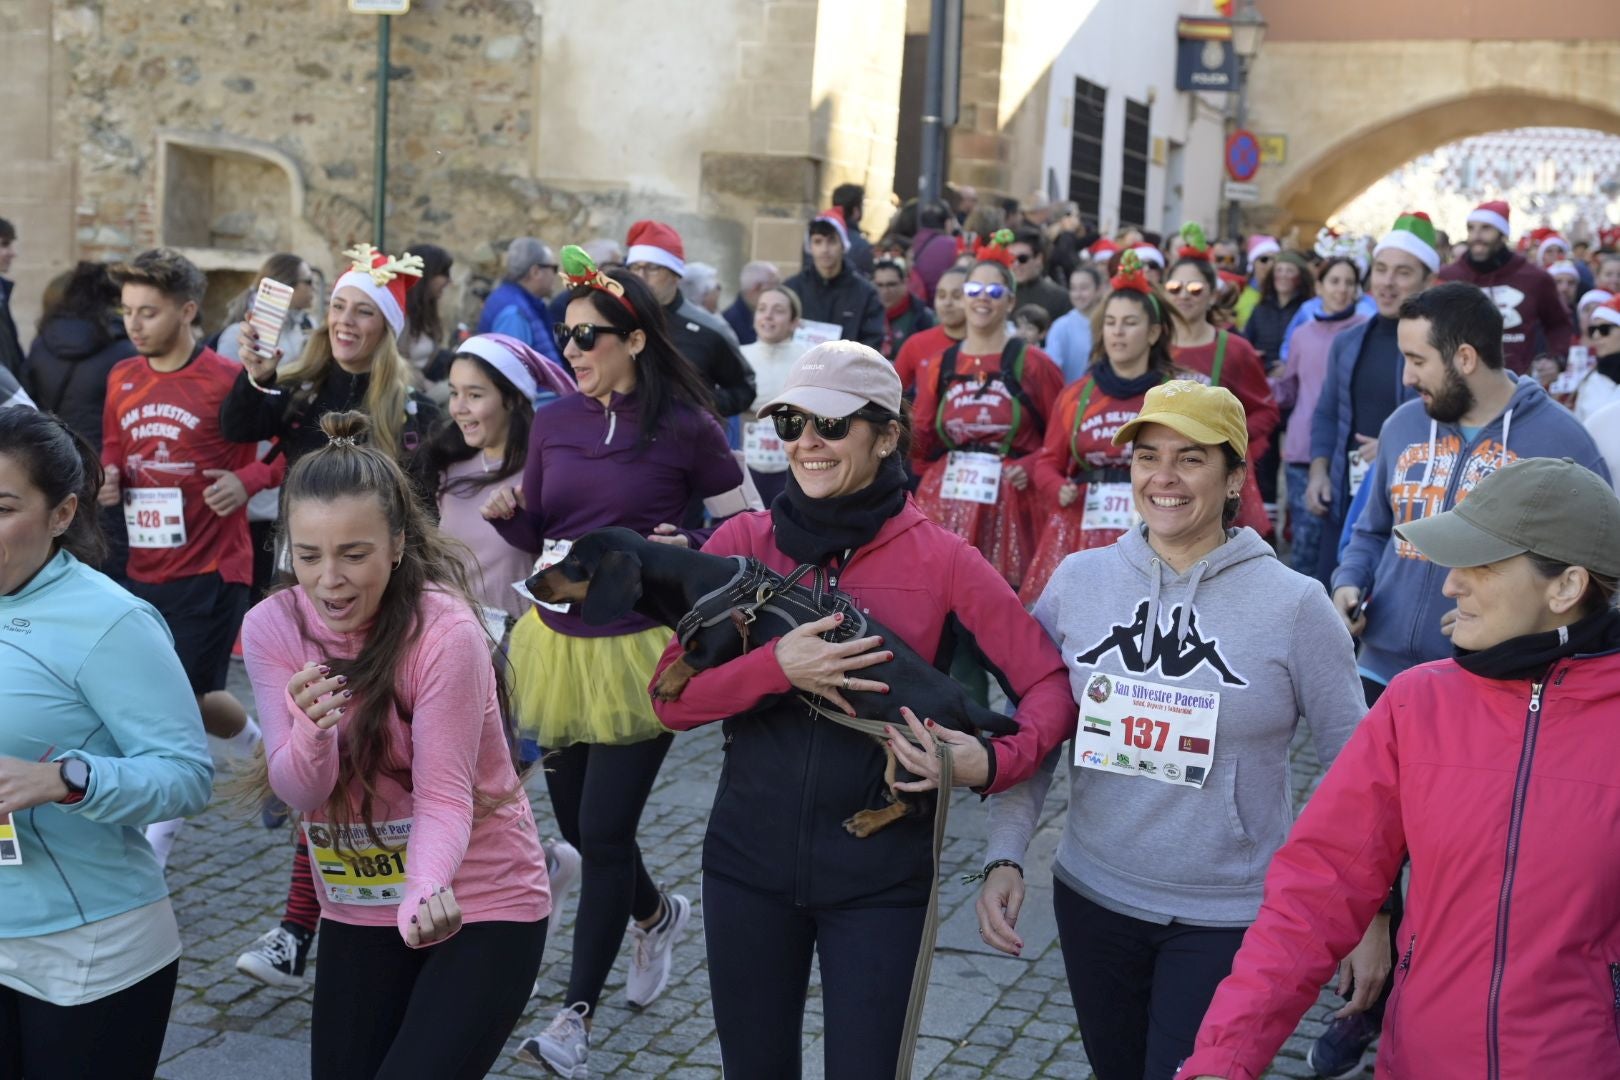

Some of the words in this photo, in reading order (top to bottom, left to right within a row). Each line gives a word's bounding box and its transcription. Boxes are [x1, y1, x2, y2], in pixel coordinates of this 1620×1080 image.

[121, 408, 140, 431] SAN
[141, 403, 201, 430] SILVESTRE
[1081, 414, 1103, 432] SAN
[131, 422, 181, 441] PACENSE
[1104, 495, 1130, 512] 371
[137, 510, 161, 528] 428
[1114, 680, 1130, 697] San
[1132, 684, 1172, 703] Silvestre
[1174, 692, 1216, 710] Pacense
[1120, 715, 1171, 753] 137
[350, 851, 406, 878] 1881
